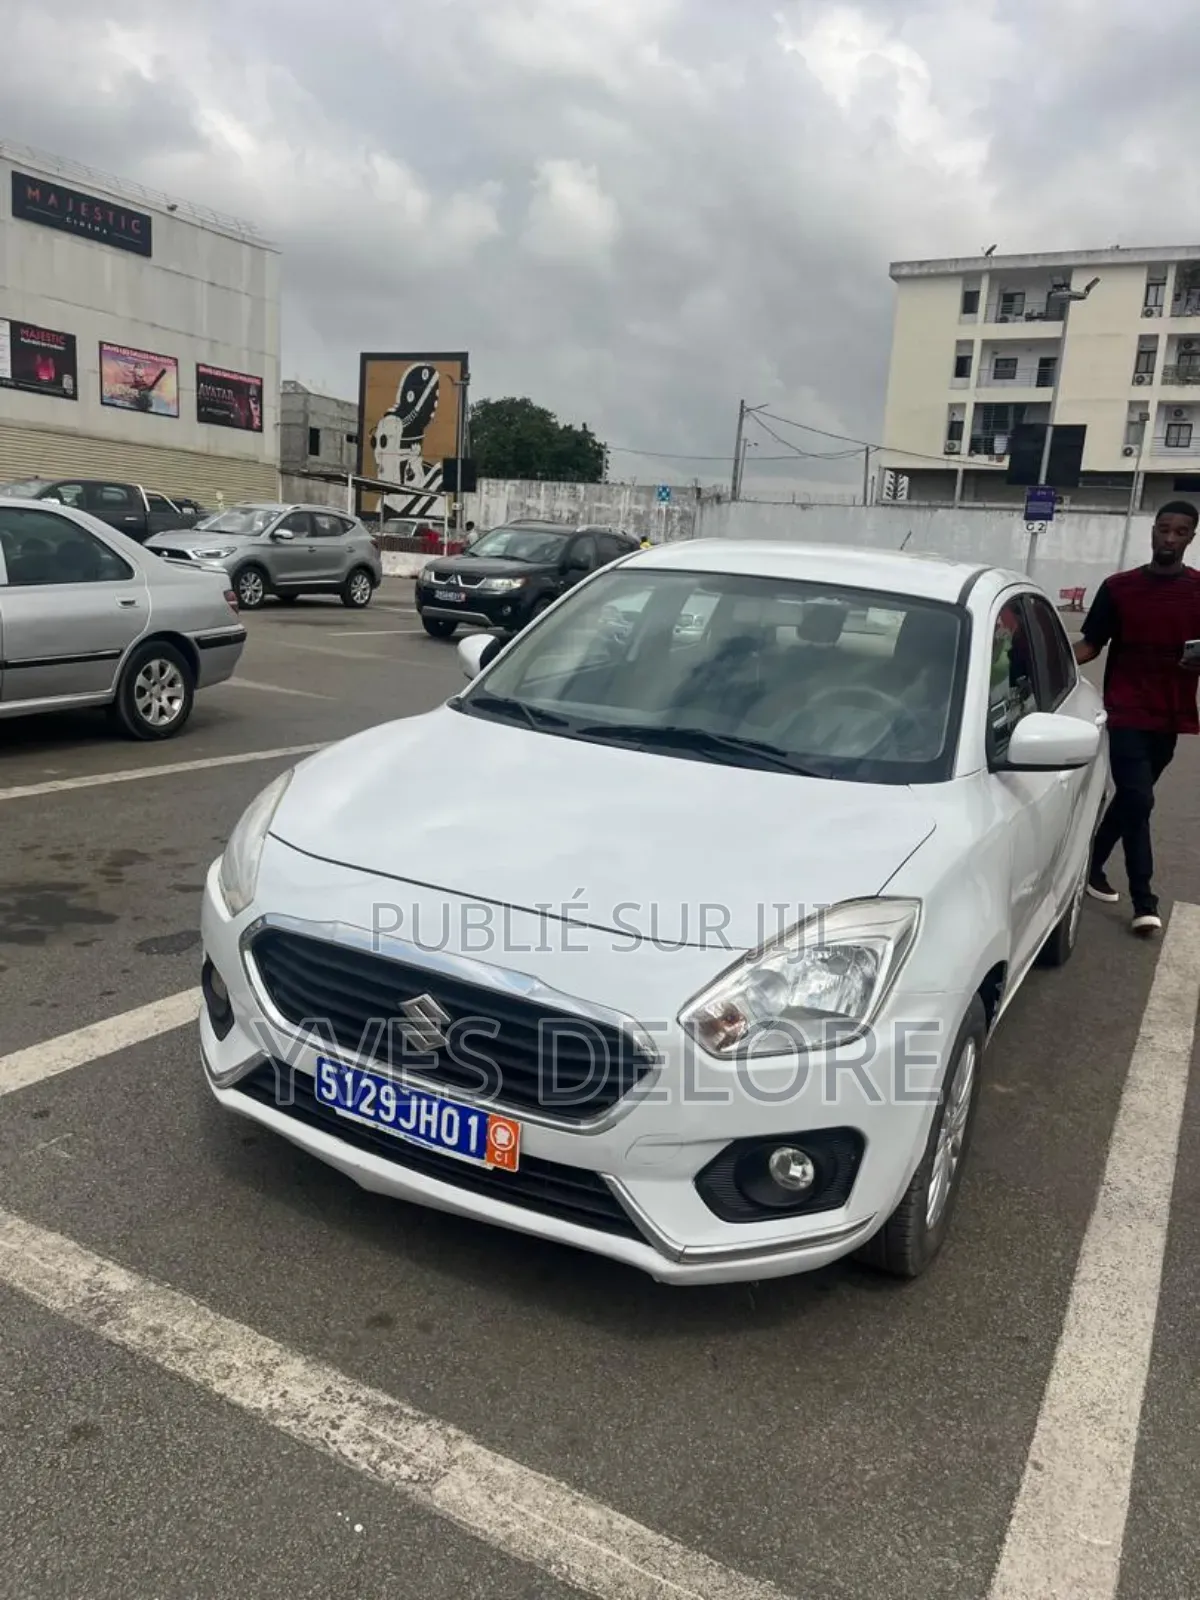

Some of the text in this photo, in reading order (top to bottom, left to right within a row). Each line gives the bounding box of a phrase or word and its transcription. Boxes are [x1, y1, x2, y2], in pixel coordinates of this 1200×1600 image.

[26, 184, 141, 234] MAJESTIC
[66, 217, 107, 234] CINEMA
[21, 328, 67, 346] MAJESTIC
[199, 383, 235, 402] AVATAR
[320, 1062, 479, 1154] 5129JH01
[494, 1150, 508, 1165] CI
